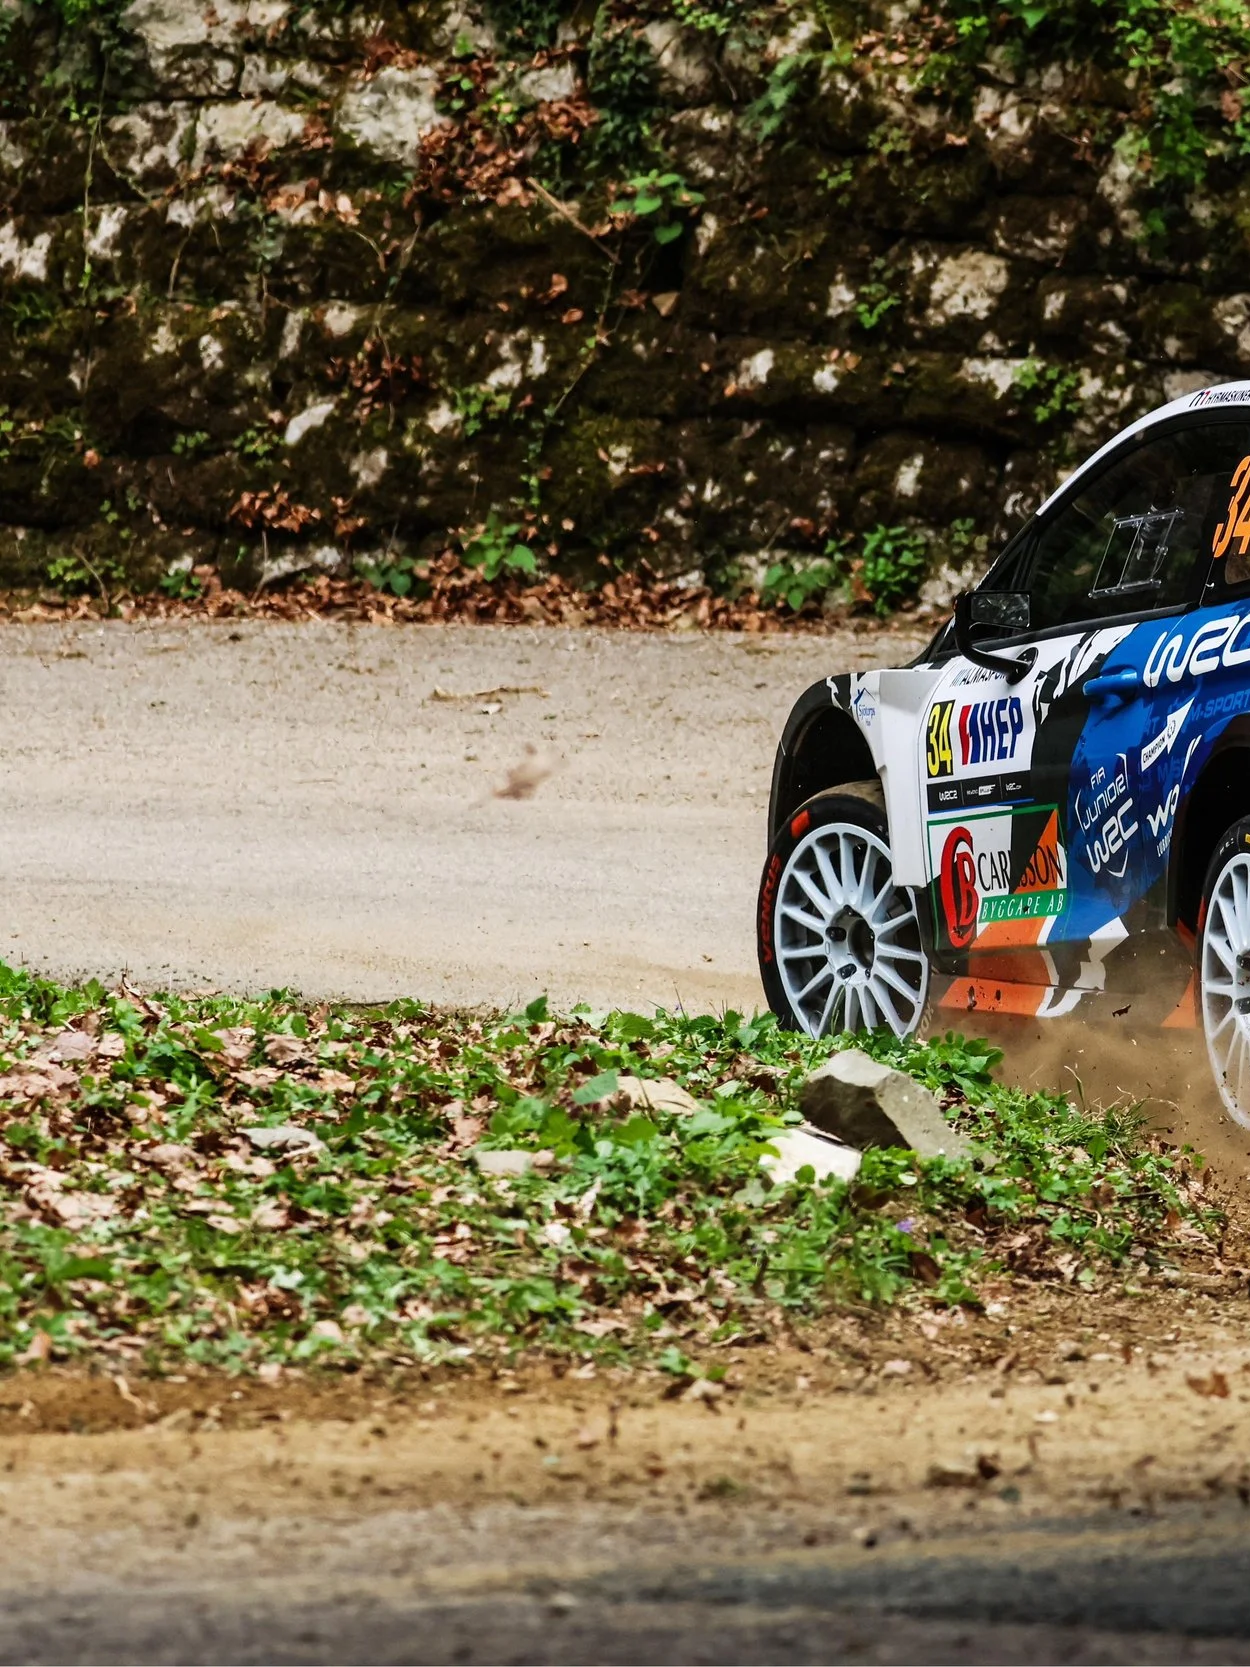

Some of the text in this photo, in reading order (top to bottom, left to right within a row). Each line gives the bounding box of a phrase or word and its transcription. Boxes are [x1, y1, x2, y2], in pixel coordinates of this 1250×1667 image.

[927, 702, 953, 777] 34
[1083, 773, 1127, 831] JUNIOR
[1090, 766, 1106, 790] FIA
[977, 843, 1064, 892] CARSON
[981, 893, 1064, 920] BYGGARE AB
